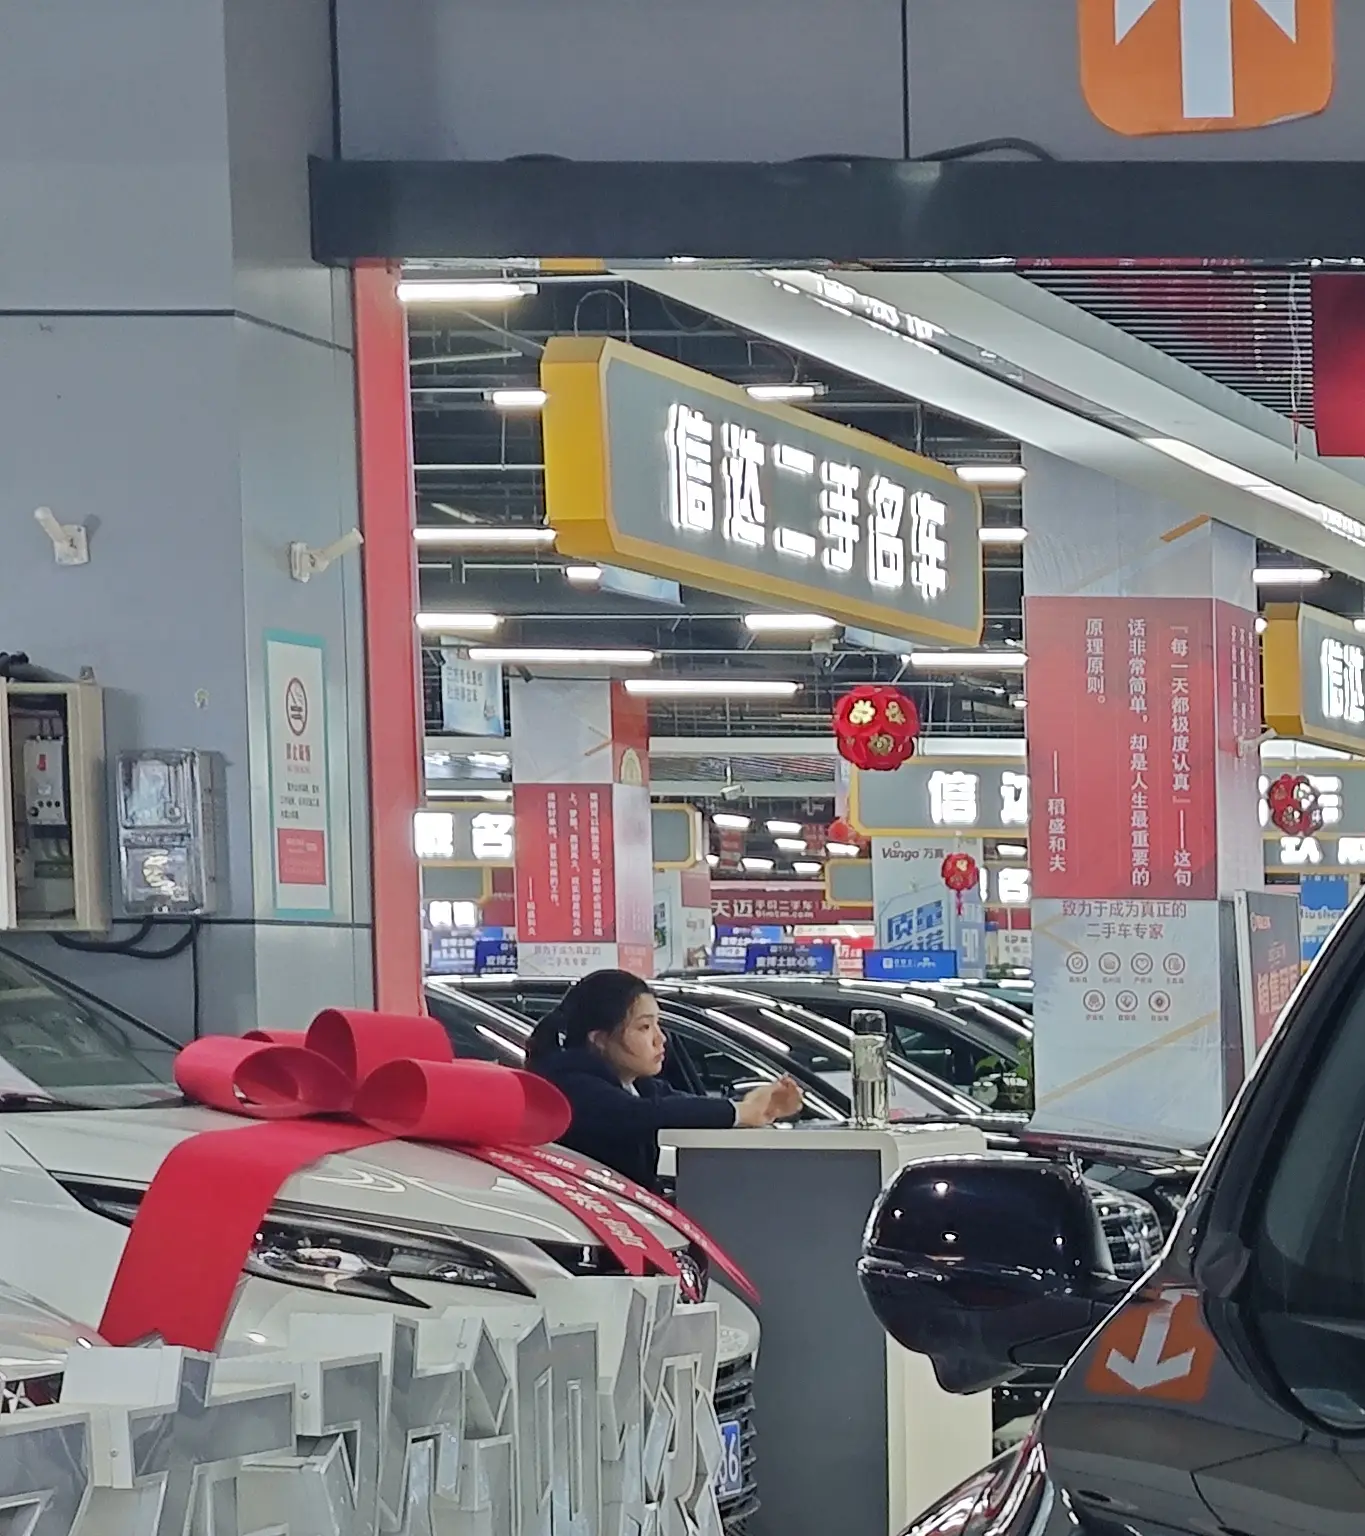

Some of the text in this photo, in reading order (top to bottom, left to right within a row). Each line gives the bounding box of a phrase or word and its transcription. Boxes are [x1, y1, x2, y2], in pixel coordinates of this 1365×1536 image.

[666, 402, 949, 600] 信达二手名车
[1085, 618, 1106, 704] 原理原则。
[1062, 900, 1187, 918] 致力于成为真正的
[1086, 923, 1164, 939] 二手车专家
